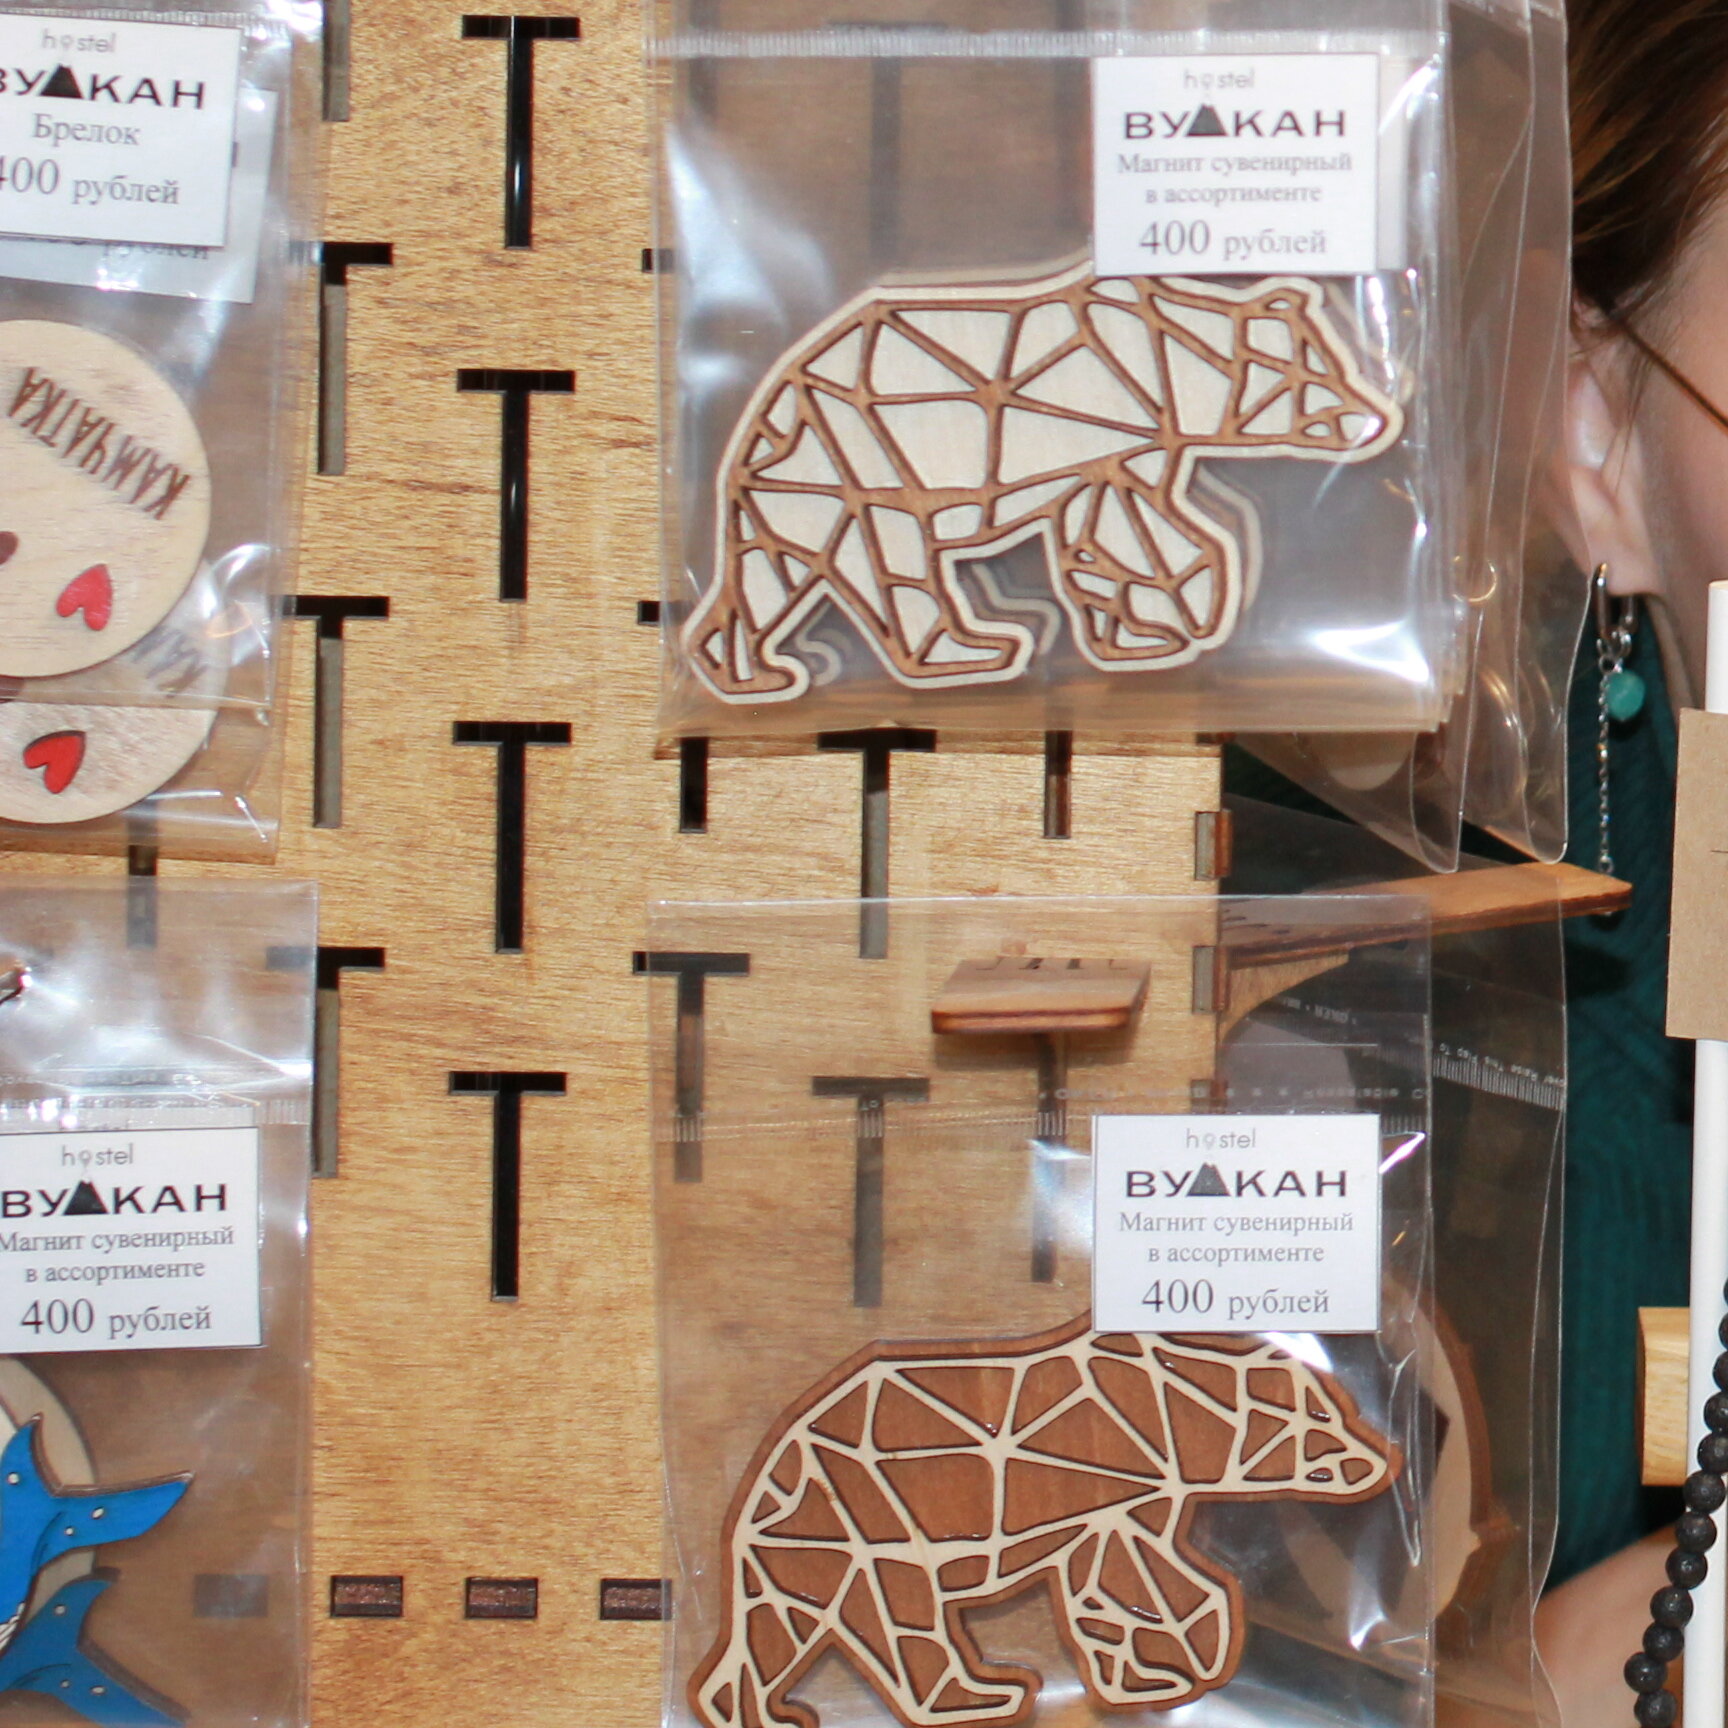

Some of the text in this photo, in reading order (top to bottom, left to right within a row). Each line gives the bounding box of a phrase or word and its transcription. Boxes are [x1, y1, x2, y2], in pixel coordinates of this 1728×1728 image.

[0, 63, 205, 109] УЛКАН
[33, 113, 140, 147] Брелок
[0, 156, 180, 204] 00 рублей
[1117, 153, 1352, 176] Магнит сувенирный
[1145, 185, 1322, 207] в ассортименте
[1139, 220, 1327, 261] 400 рублей
[7, 367, 191, 520] КАМЧАТКА
[0, 1226, 234, 1253] Магнит сувенирный
[1119, 1212, 1353, 1236] Магнит сувенирный
[1148, 1245, 1325, 1267] в ассортименте
[26, 1262, 205, 1286] в ассортименте
[1141, 1279, 1329, 1320] 400 рублей
[20, 1298, 212, 1340] 400 рублей
